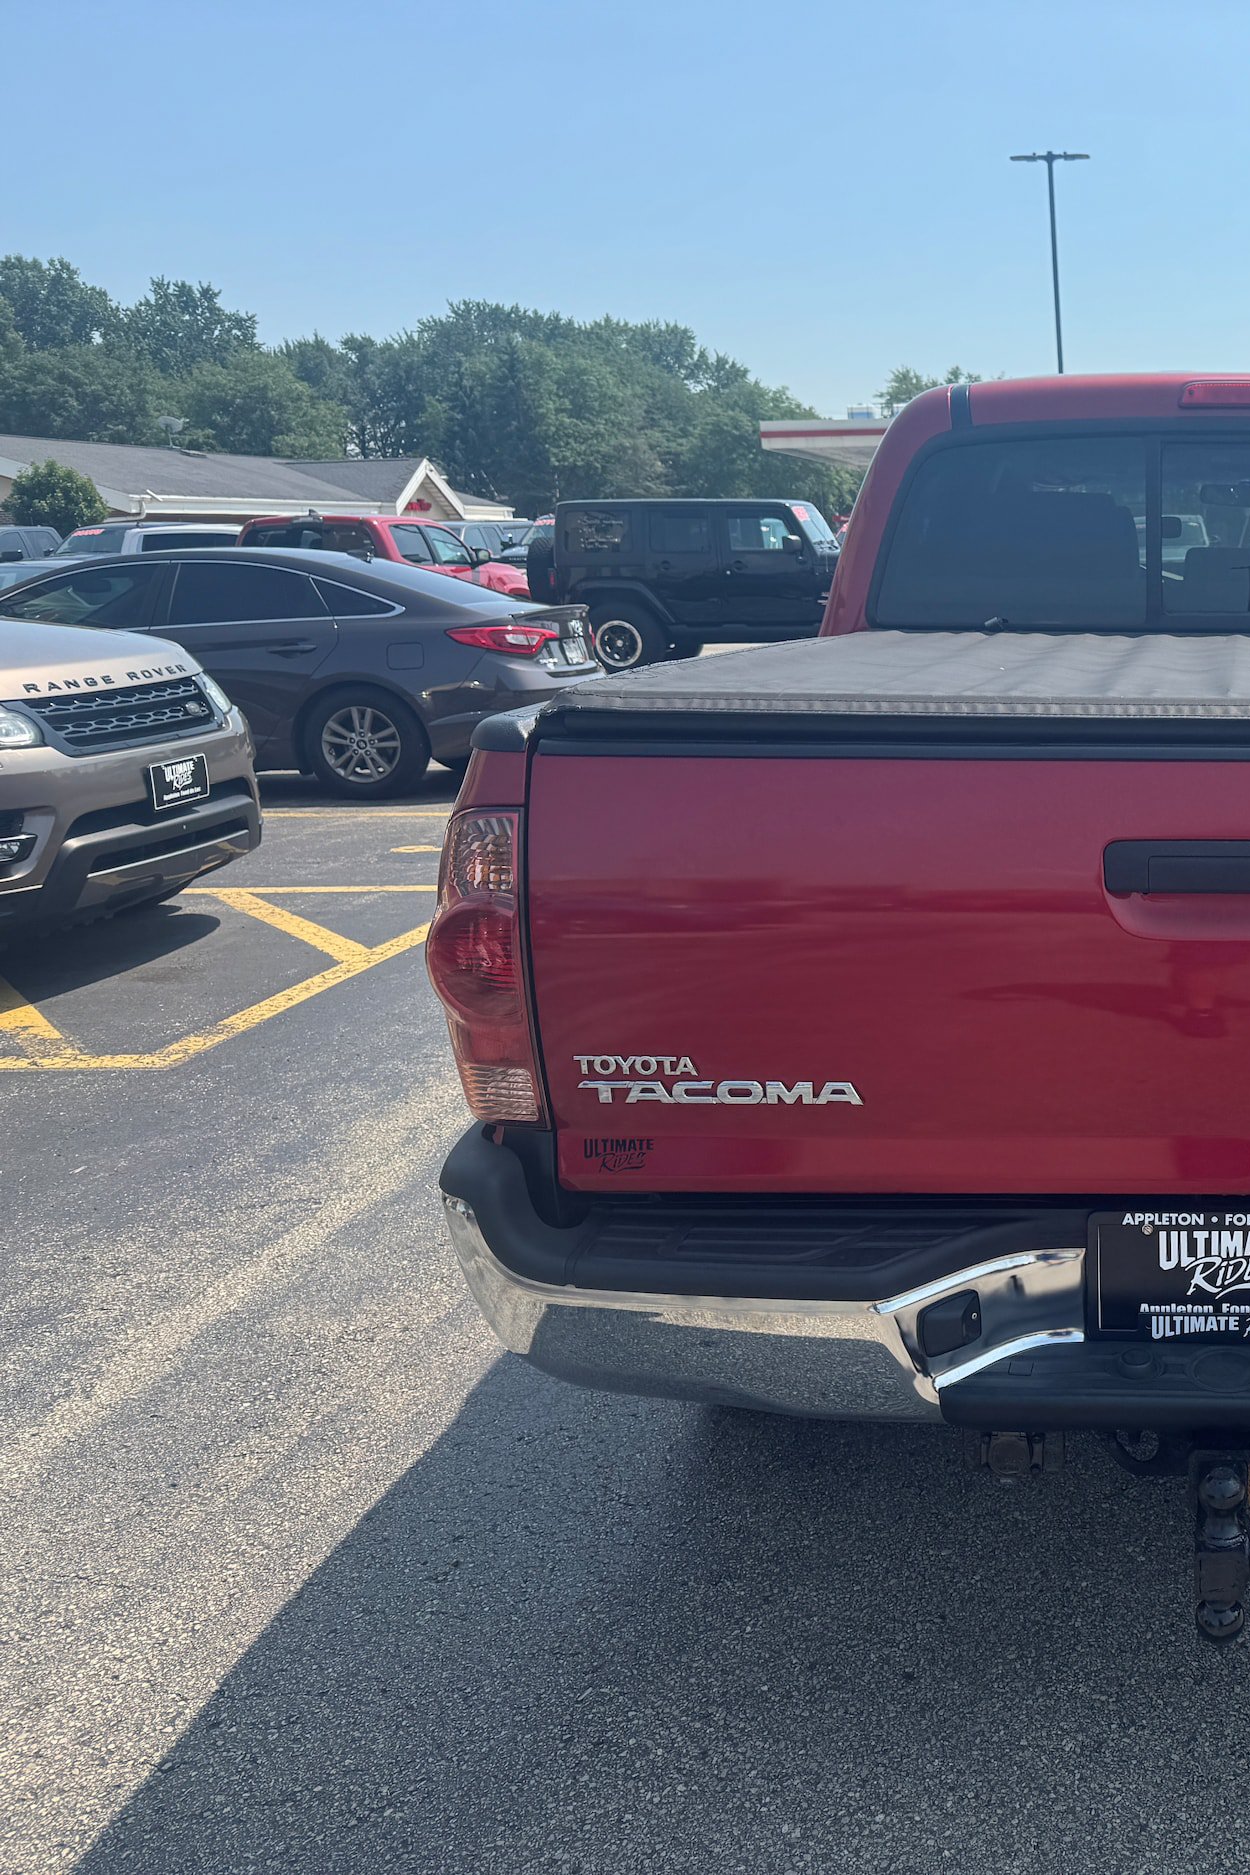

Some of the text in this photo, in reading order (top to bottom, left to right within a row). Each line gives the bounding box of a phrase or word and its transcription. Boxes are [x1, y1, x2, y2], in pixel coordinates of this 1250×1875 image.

[22, 664, 187, 693] RANGE ROVER
[164, 761, 195, 782] ULTIMATE
[573, 1055, 698, 1076] TOYOTA
[577, 1080, 863, 1106] TACOMA
[584, 1138, 654, 1159] ULTIMATE
[1122, 1213, 1205, 1226] APPLETON
[1151, 1316, 1240, 1340] ULTIMATE
